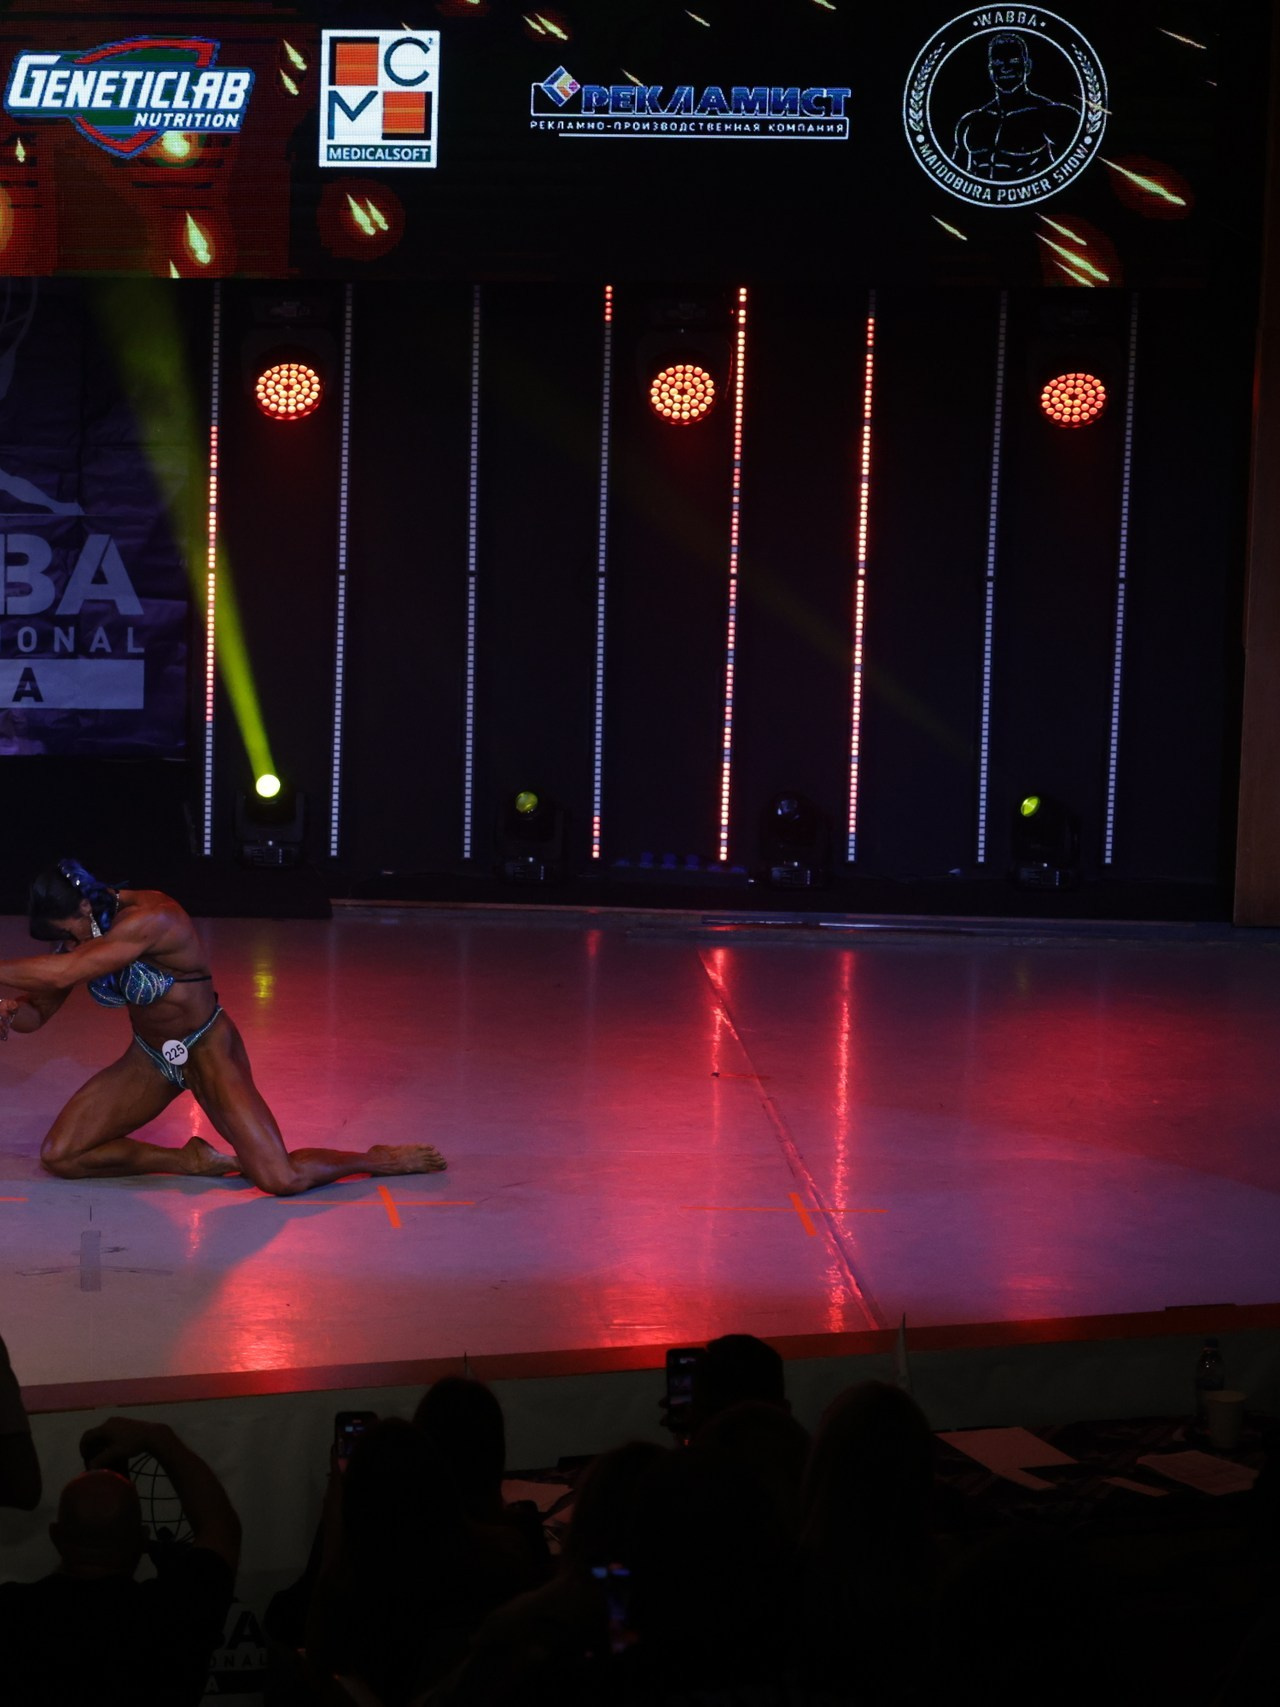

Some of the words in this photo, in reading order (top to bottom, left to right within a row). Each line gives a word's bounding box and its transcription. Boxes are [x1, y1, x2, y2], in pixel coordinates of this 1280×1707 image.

[976, 10, 1038, 28] WABBA
[7, 54, 251, 110] GENETICLAB
[580, 85, 852, 117] РЕКЛАМИСТ
[133, 112, 240, 128] NUTRITION
[530, 120, 761, 132] РЕКЛАМНО-ПРОИЗВОДСТВЕННАЯ
[768, 122, 844, 133] КОМПАНИЯ
[328, 147, 429, 160] MEDICALSOFT
[996, 180, 1052, 201] POWER
[1052, 143, 1090, 183] SHOW
[165, 1044, 185, 1061] 225
